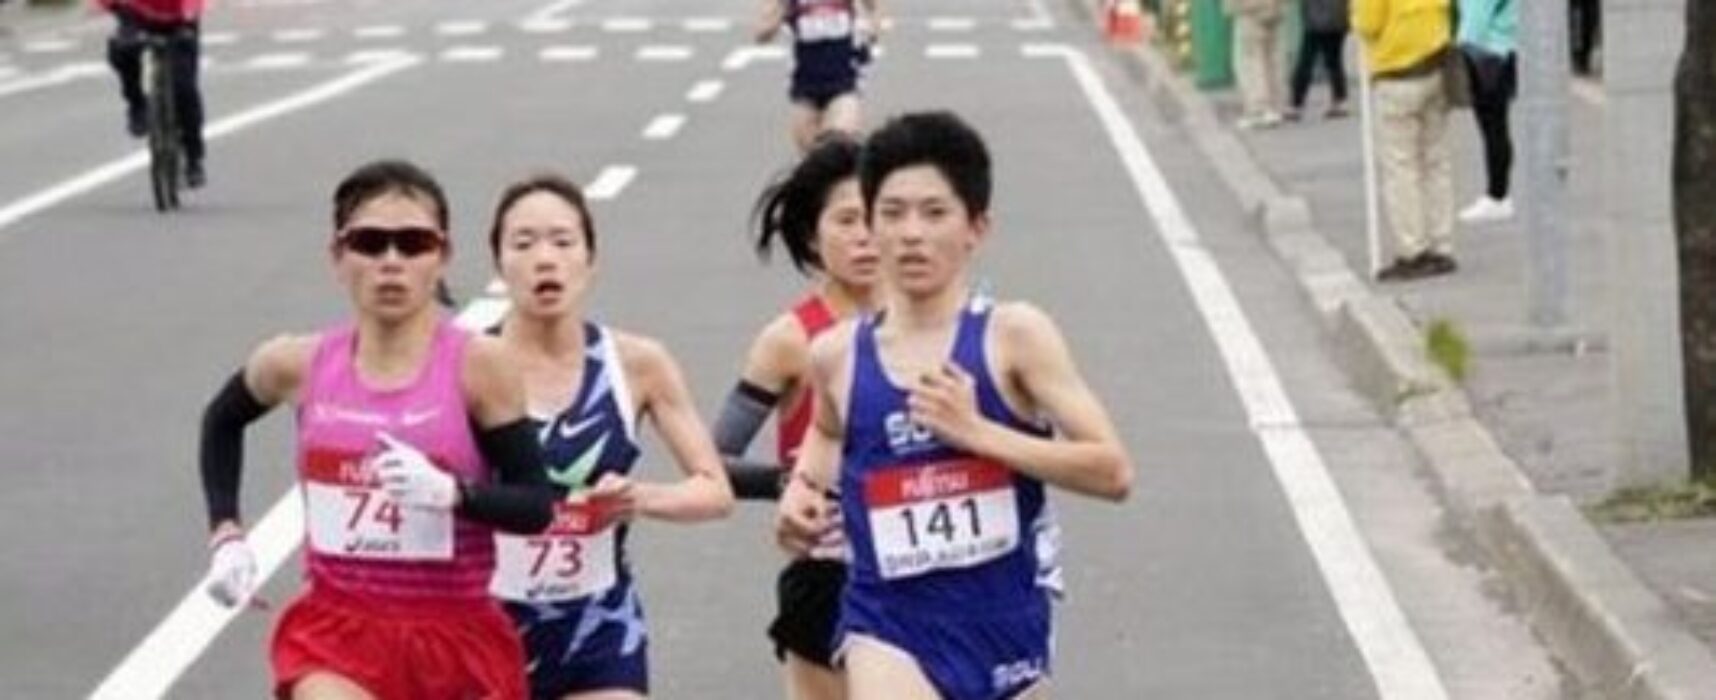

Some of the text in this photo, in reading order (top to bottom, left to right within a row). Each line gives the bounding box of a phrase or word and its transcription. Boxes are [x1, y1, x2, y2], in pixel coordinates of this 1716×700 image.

[343, 491, 403, 534] 74
[902, 497, 981, 547] 141
[527, 539, 582, 578] 73
